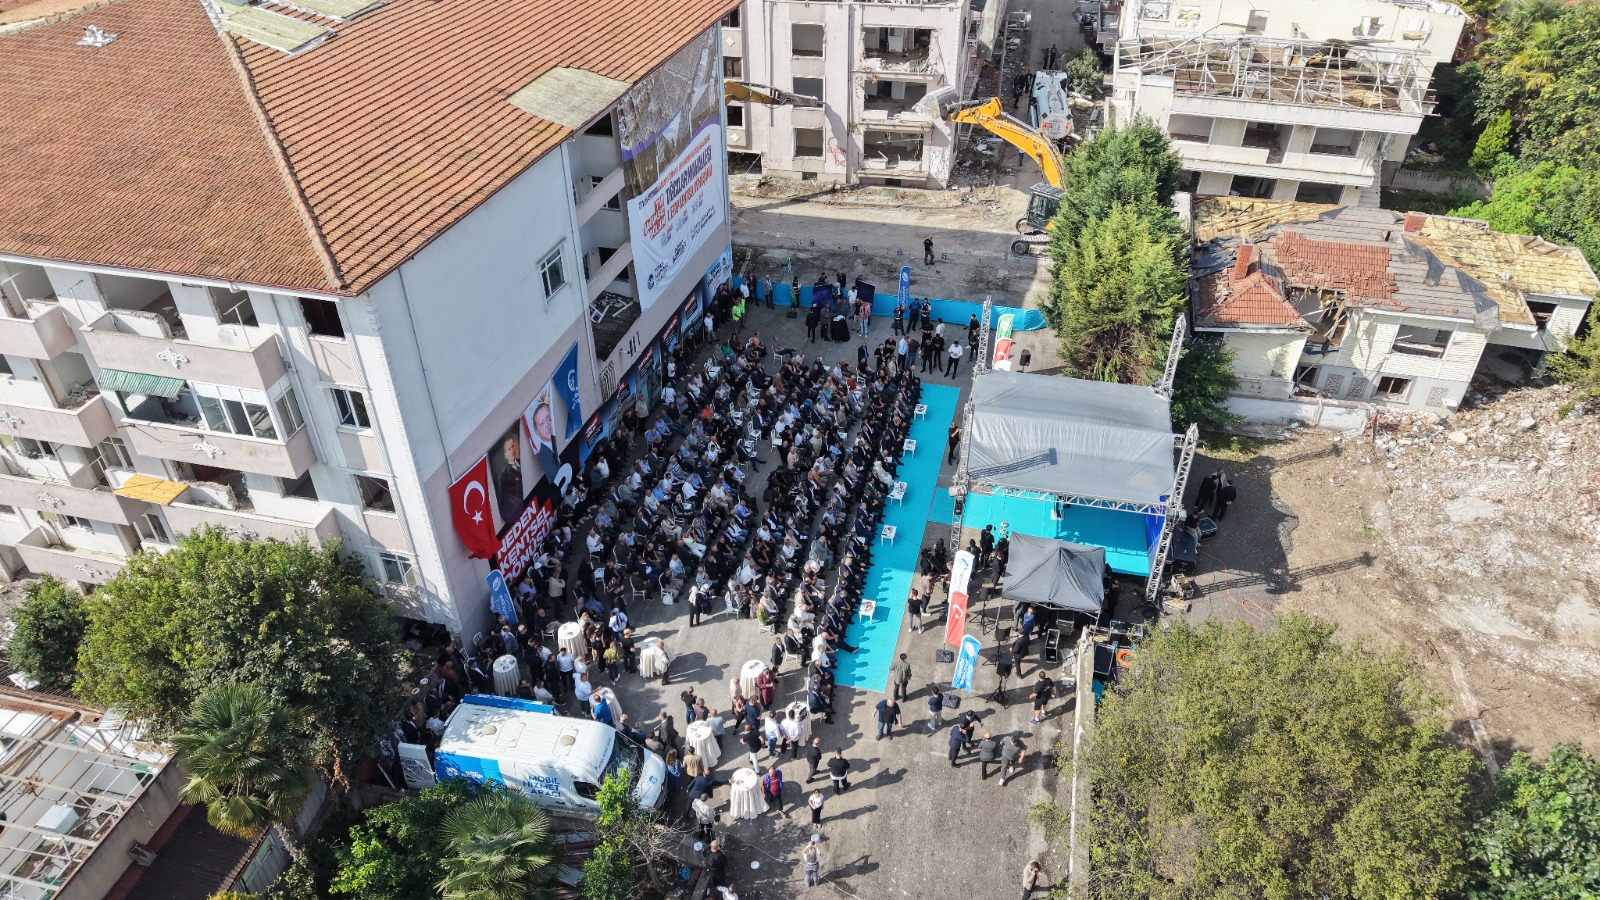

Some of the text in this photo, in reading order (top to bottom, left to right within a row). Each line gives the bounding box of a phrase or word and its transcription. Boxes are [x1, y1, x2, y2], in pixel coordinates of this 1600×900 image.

[497, 501, 537, 559] NEDEN
[500, 506, 550, 574] KENTSEL
[531, 789, 561, 797] ARACI
